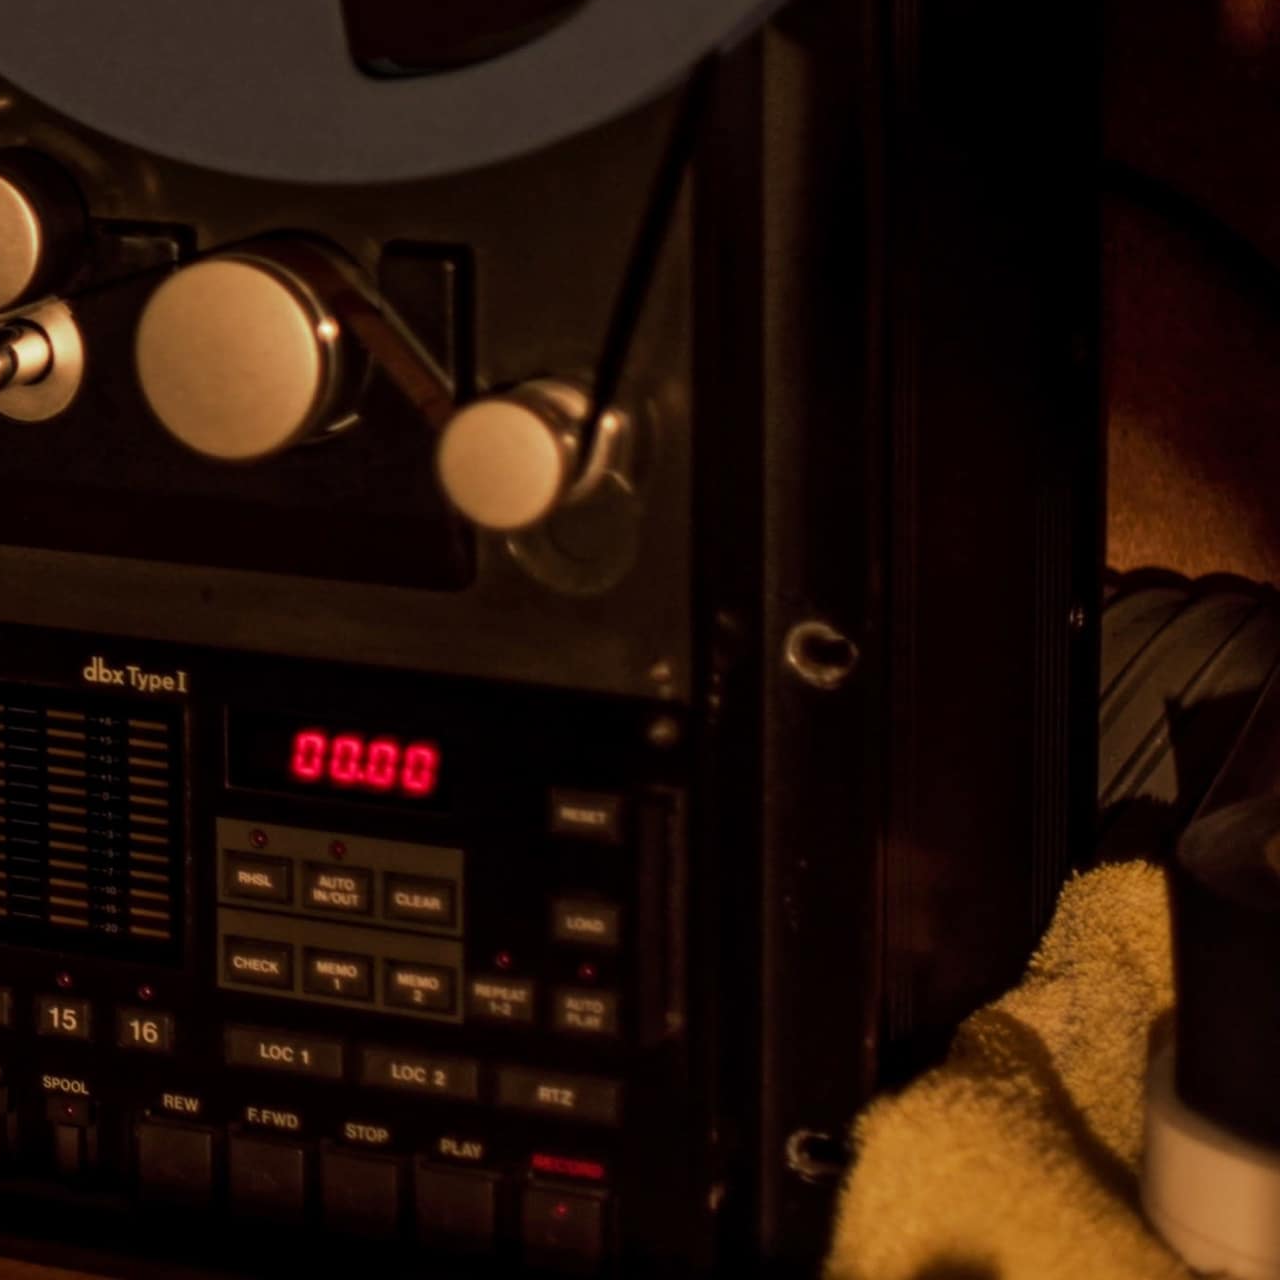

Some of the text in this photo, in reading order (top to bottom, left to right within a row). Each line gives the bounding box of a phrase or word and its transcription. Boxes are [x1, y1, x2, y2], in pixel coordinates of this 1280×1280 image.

[82, 655, 125, 685] dbx
[126, 665, 175, 693] Type
[291, 727, 440, 797] 00.00
[318, 874, 355, 891] AUTO
[312, 887, 360, 907] IN/OUT
[394, 891, 442, 910] CLEAR
[233, 955, 279, 975] CHECK
[316, 961, 358, 979] MEMO
[396, 971, 440, 991] MEMO
[48, 1007, 77, 1031] 15
[129, 1019, 159, 1043] 16
[259, 1043, 310, 1065] LOC 1
[42, 1075, 90, 1095] SPOOL
[391, 1062, 446, 1087] LOC 2
[163, 1093, 200, 1113] REW
[537, 1085, 576, 1107] RTZ
[246, 1106, 299, 1130] F.FWD
[344, 1122, 390, 1144] STOP
[440, 1137, 483, 1161] PLAY
